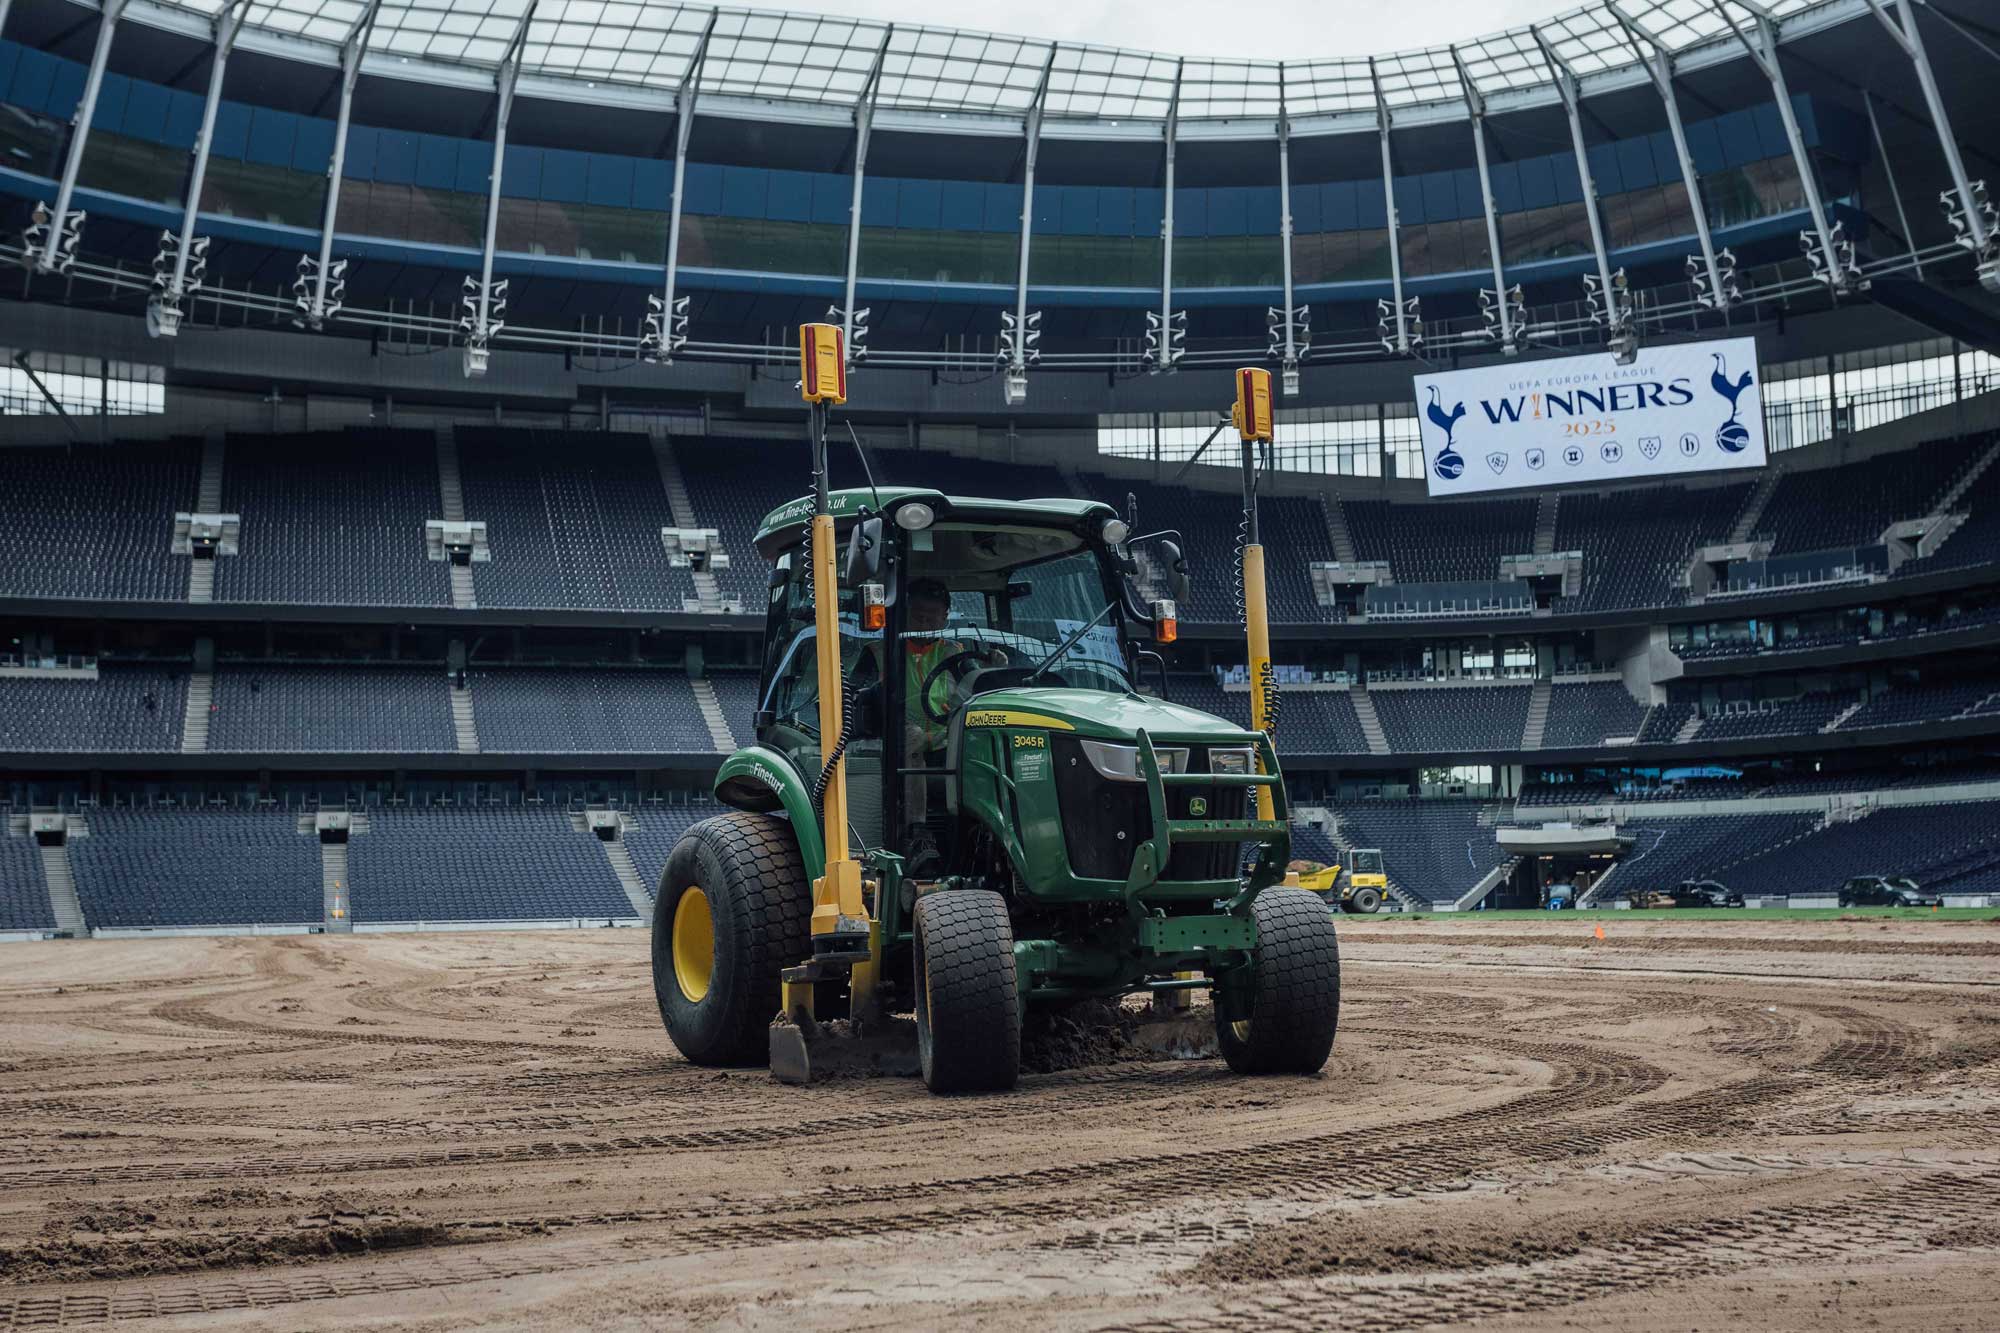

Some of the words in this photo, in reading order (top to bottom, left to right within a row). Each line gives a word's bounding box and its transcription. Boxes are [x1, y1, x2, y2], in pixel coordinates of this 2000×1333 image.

[1509, 380, 1541, 391] UEFA
[1547, 373, 1599, 386] EUROPA
[1604, 367, 1657, 380] LEAGUE
[1560, 418, 1616, 438] 2025
[753, 762, 786, 794] Fineturf
